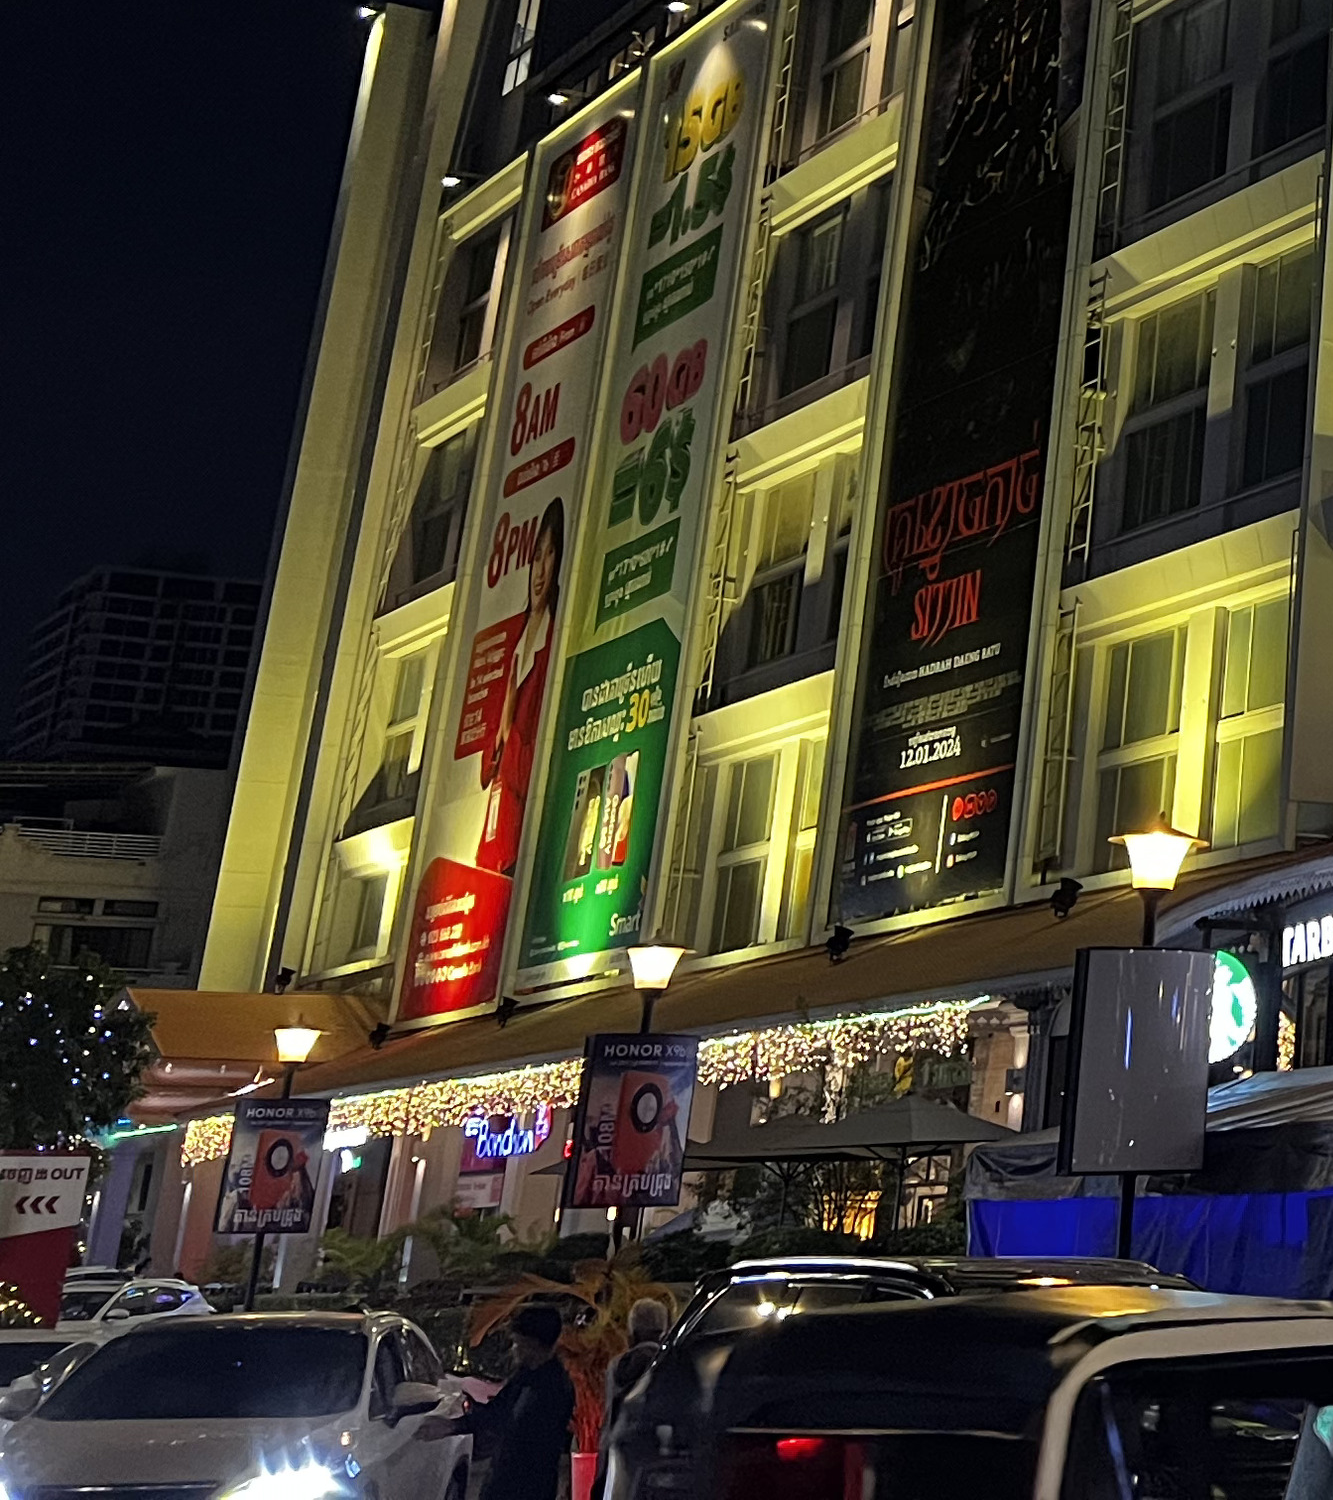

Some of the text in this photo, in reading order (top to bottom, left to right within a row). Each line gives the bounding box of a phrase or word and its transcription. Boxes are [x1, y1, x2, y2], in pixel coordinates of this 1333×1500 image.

[619, 337, 708, 447] 60GB
[510, 381, 561, 457] 8AM
[486, 511, 539, 589] 8PM
[625, 688, 651, 733] 30
[899, 735, 962, 770] 12.01.2024
[608, 908, 641, 937] Smart
[603, 1043, 663, 1058] HONOR
[245, 1107, 295, 1119] HONOR
[50, 1167, 85, 1181] OUT
